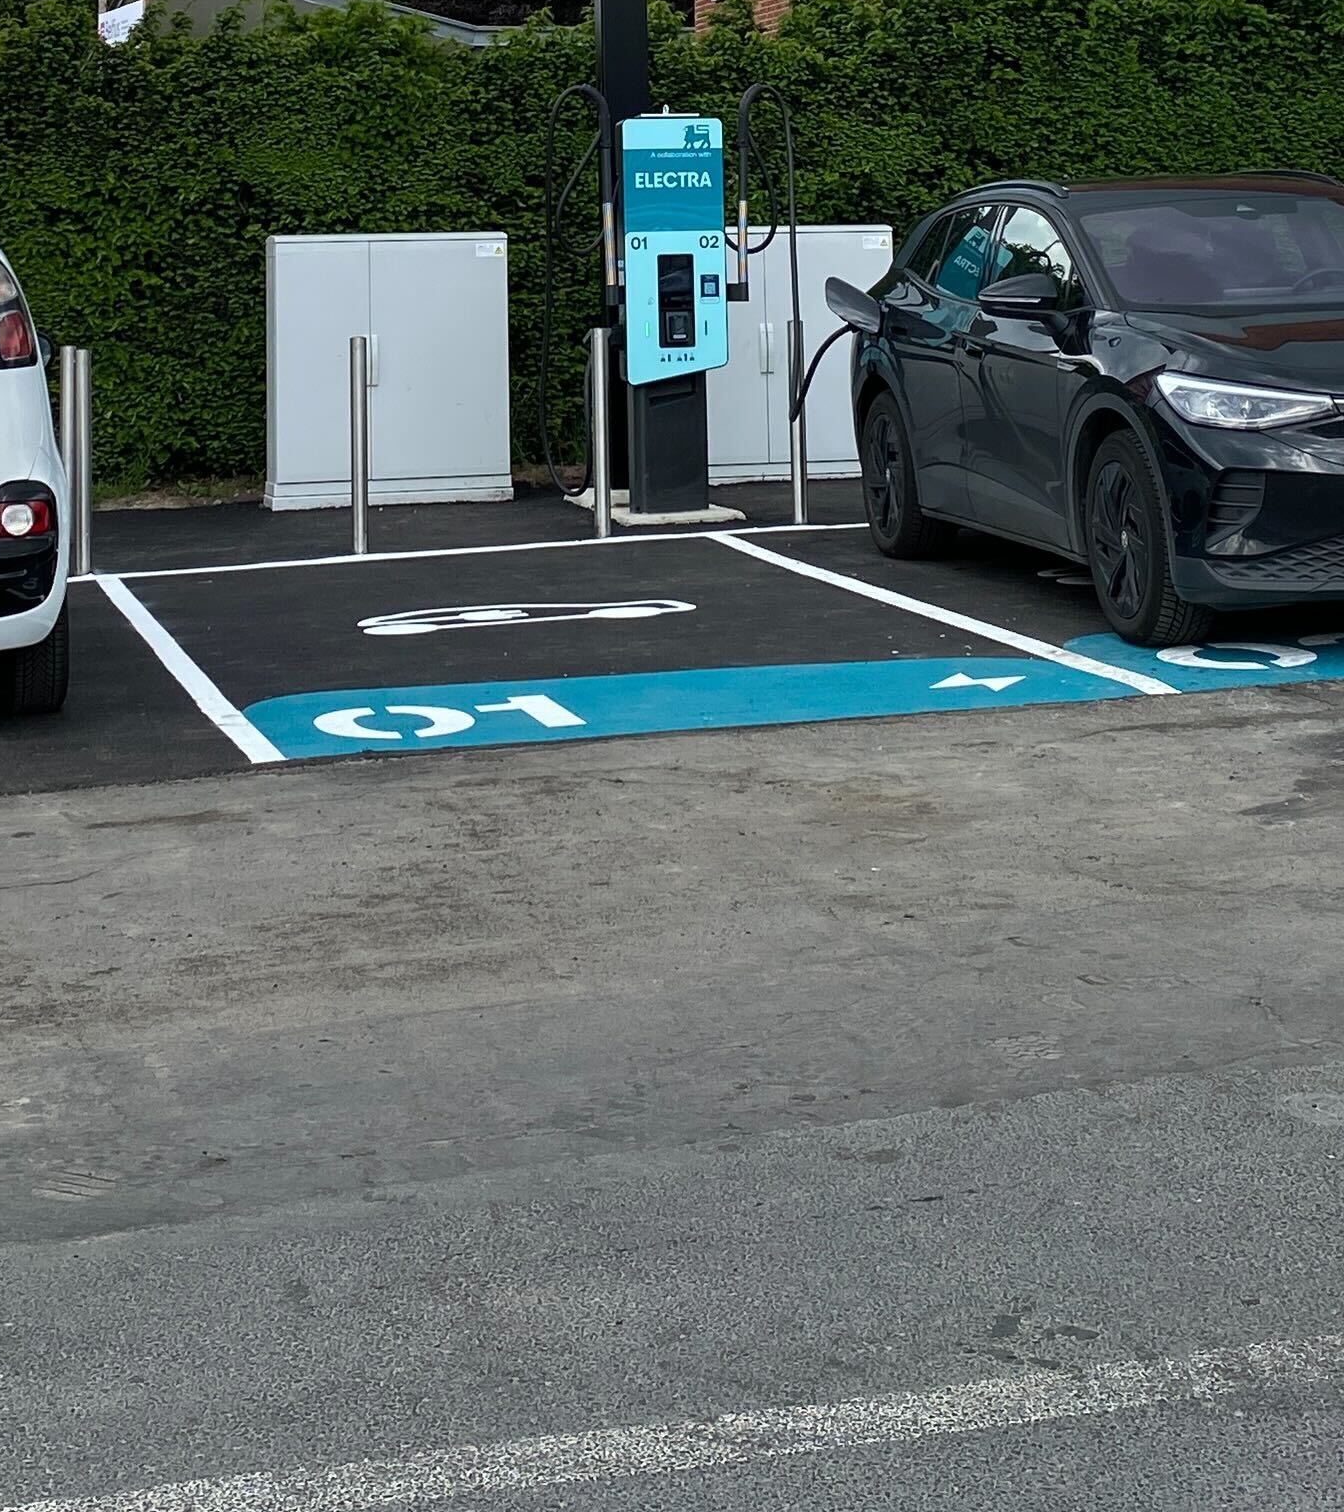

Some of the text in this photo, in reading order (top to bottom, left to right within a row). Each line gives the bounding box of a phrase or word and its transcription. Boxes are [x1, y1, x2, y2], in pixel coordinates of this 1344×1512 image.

[635, 171, 712, 189] ELECTRA
[630, 235, 719, 250] 01 02
[313, 694, 588, 740] 01
